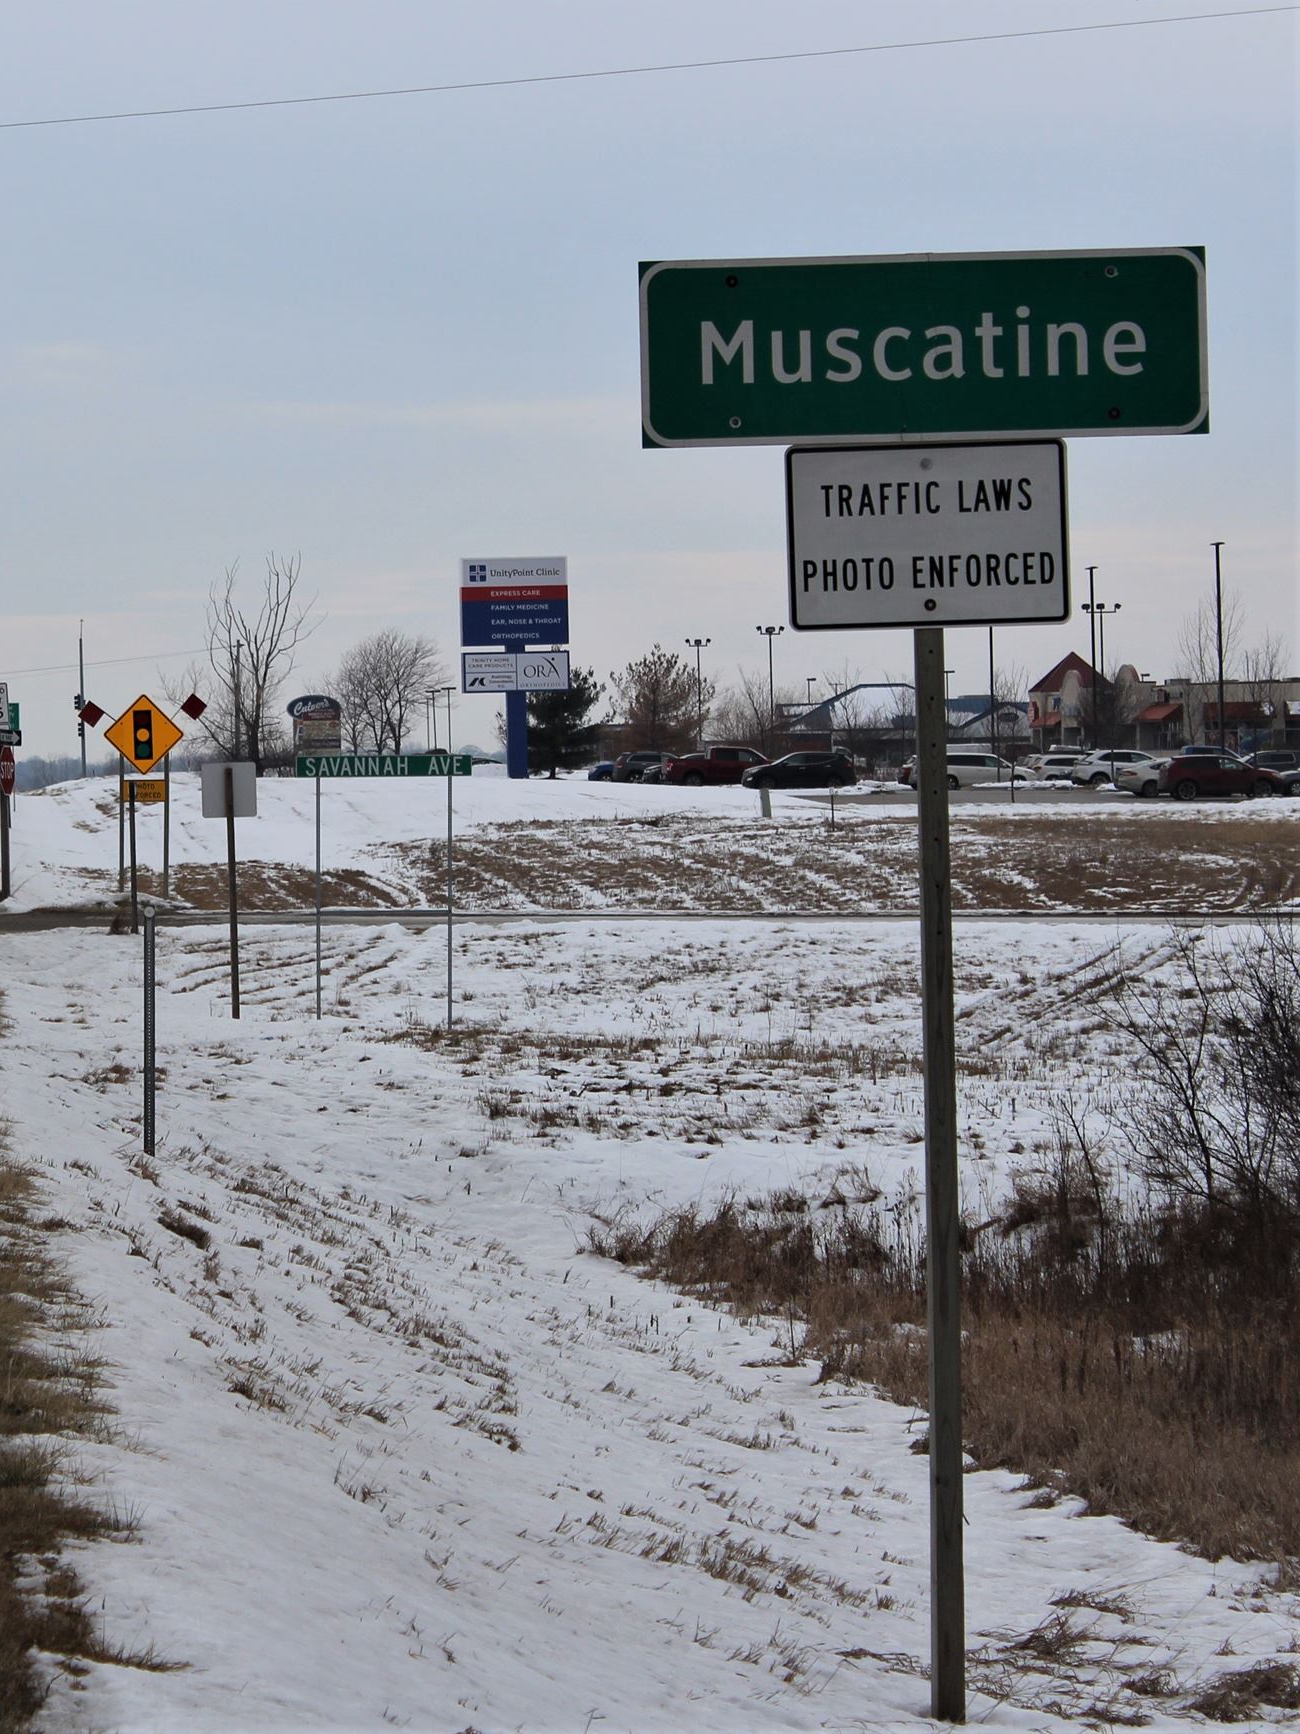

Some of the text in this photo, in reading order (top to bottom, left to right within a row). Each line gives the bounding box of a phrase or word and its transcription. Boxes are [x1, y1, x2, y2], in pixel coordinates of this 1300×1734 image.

[699, 305, 1147, 385] Muscatine
[820, 477, 1034, 518] TRAFFIC LAWS
[490, 567, 560, 578] UnityPoint Clinic
[802, 551, 1055, 592] PHOTO ENFORCED
[0, 762, 14, 779] STOP
[305, 756, 463, 776] SAVANNAH AVE
